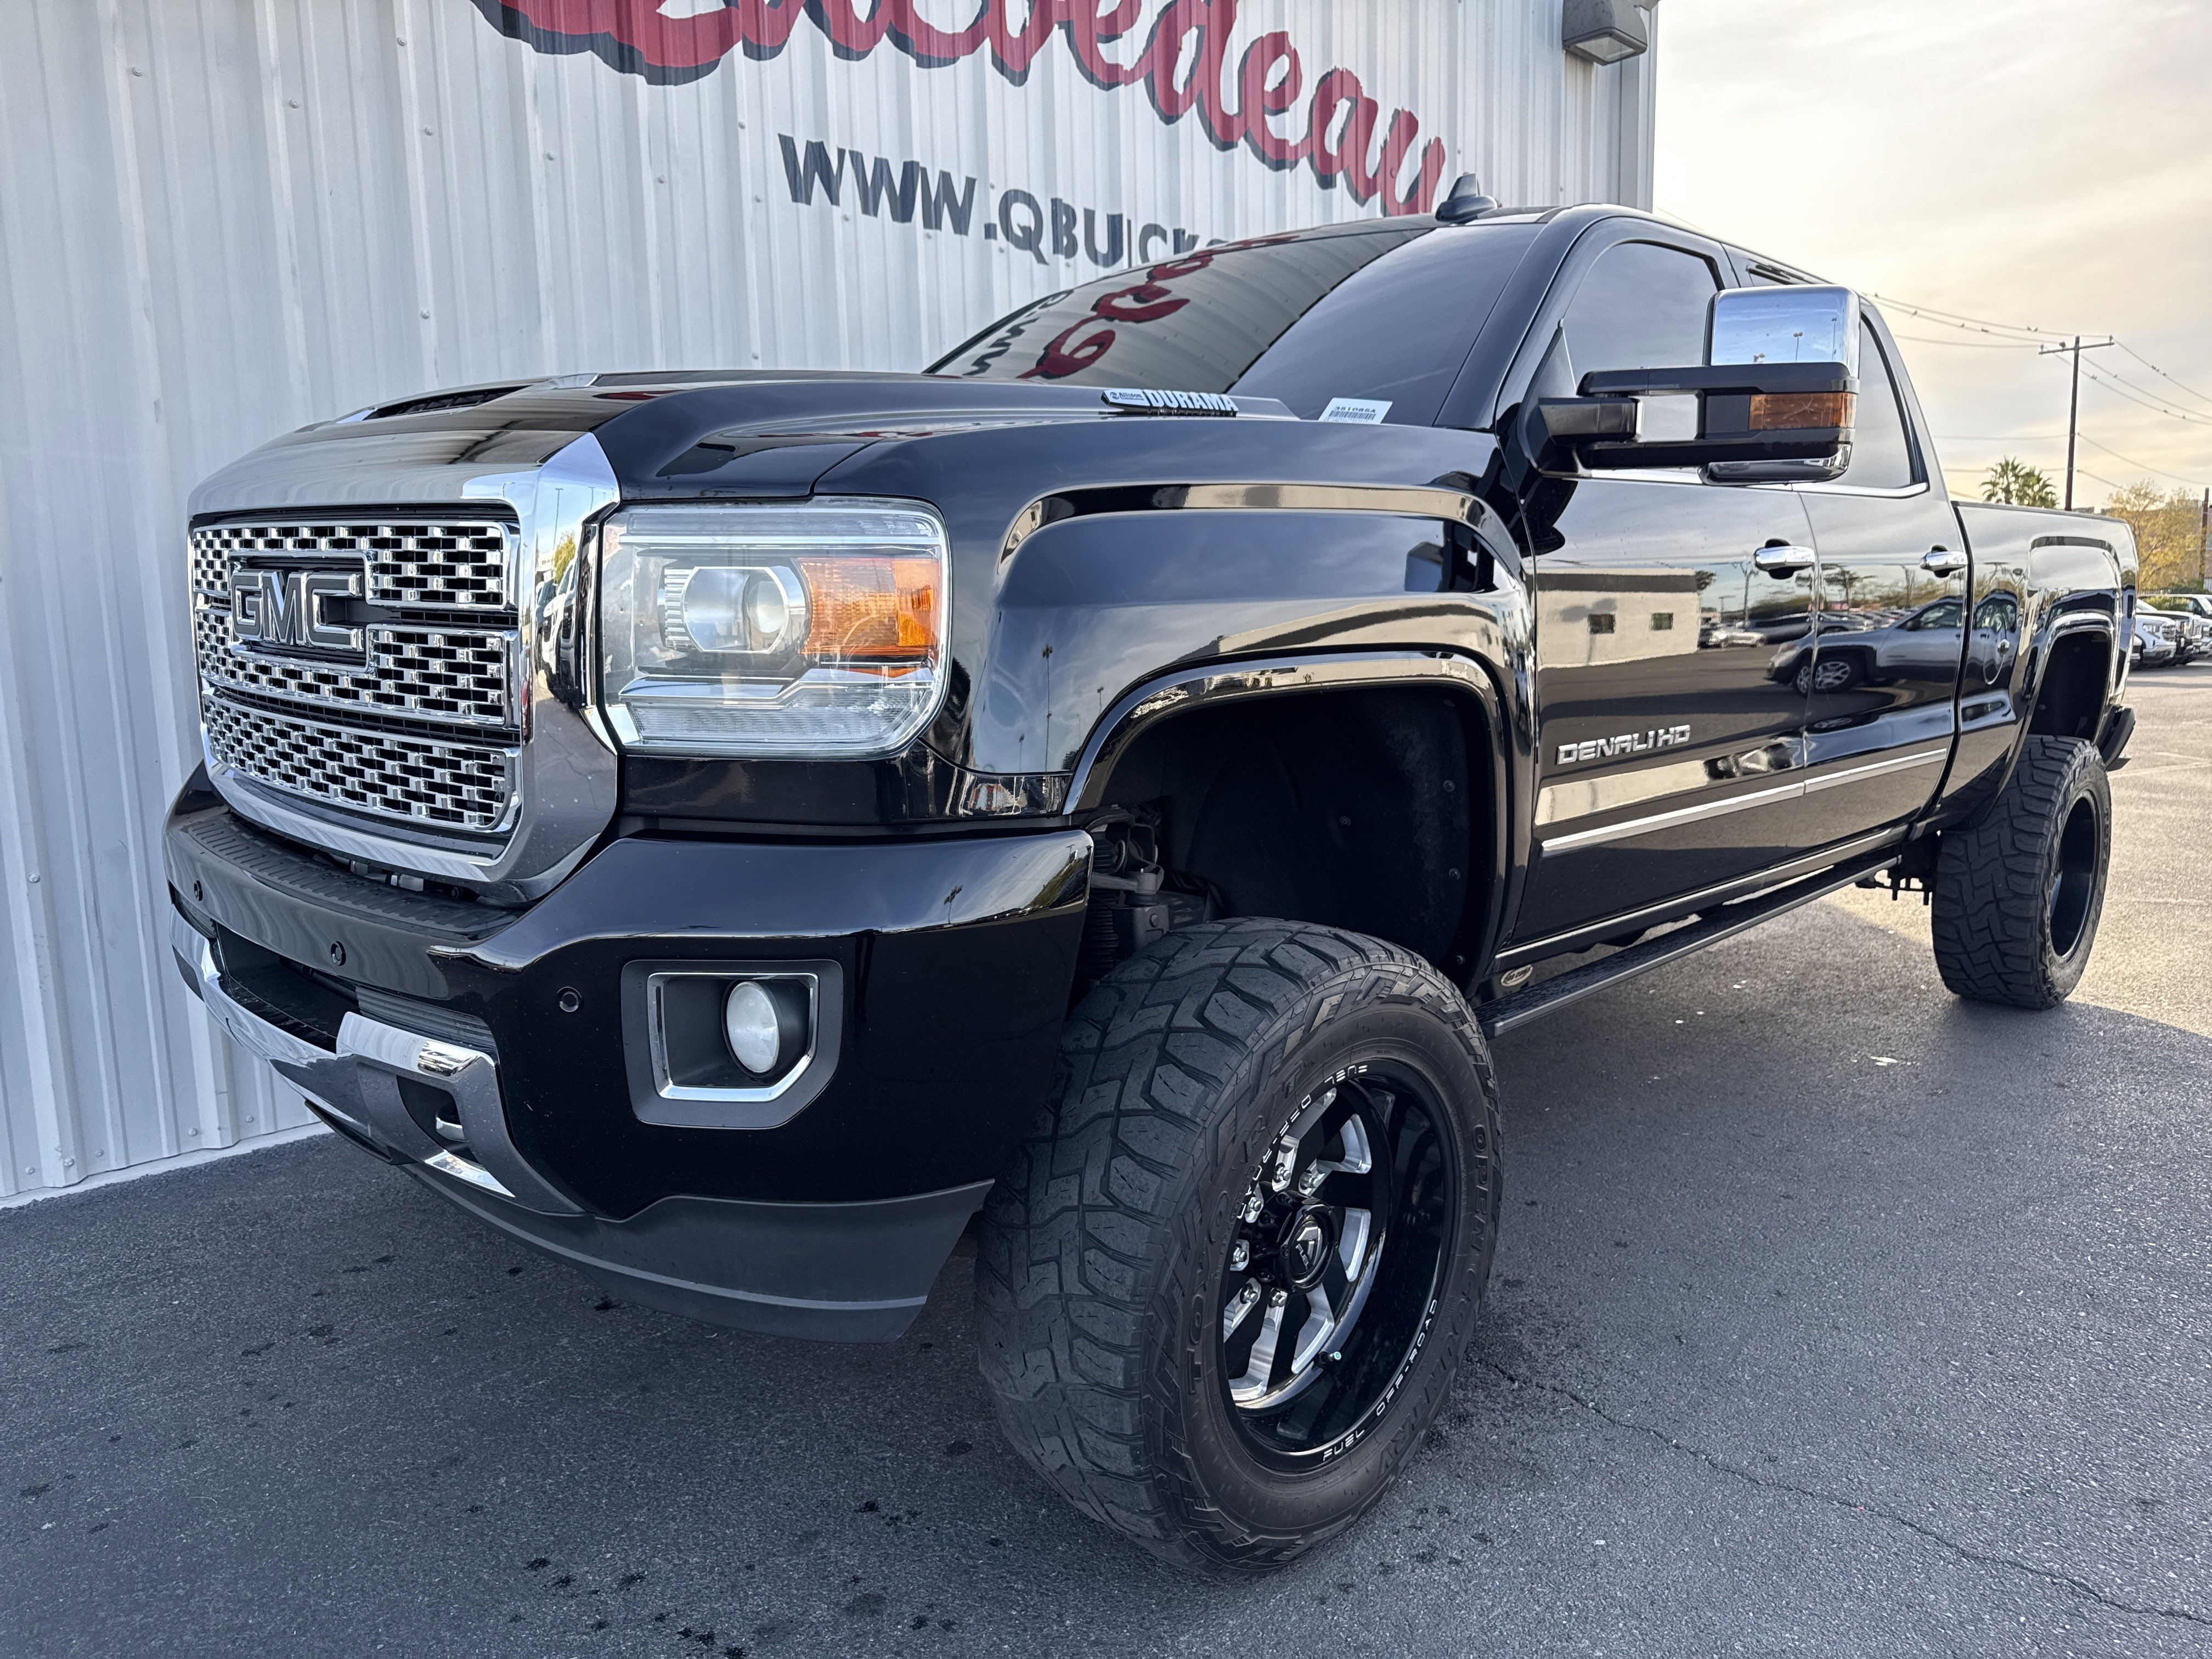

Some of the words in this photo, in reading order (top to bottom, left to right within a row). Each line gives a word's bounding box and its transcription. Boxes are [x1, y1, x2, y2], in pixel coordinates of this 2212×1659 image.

[230, 570, 365, 652] GMC
[1556, 730, 1655, 765] DENALI
[1658, 724, 1691, 747] HD
[1324, 1064, 1368, 1085] FUEL
[1470, 1124, 1489, 1252] OPEN
[1322, 1429, 1365, 1462] FUEL
[1376, 1299, 1438, 1417] OFF-ROAD
